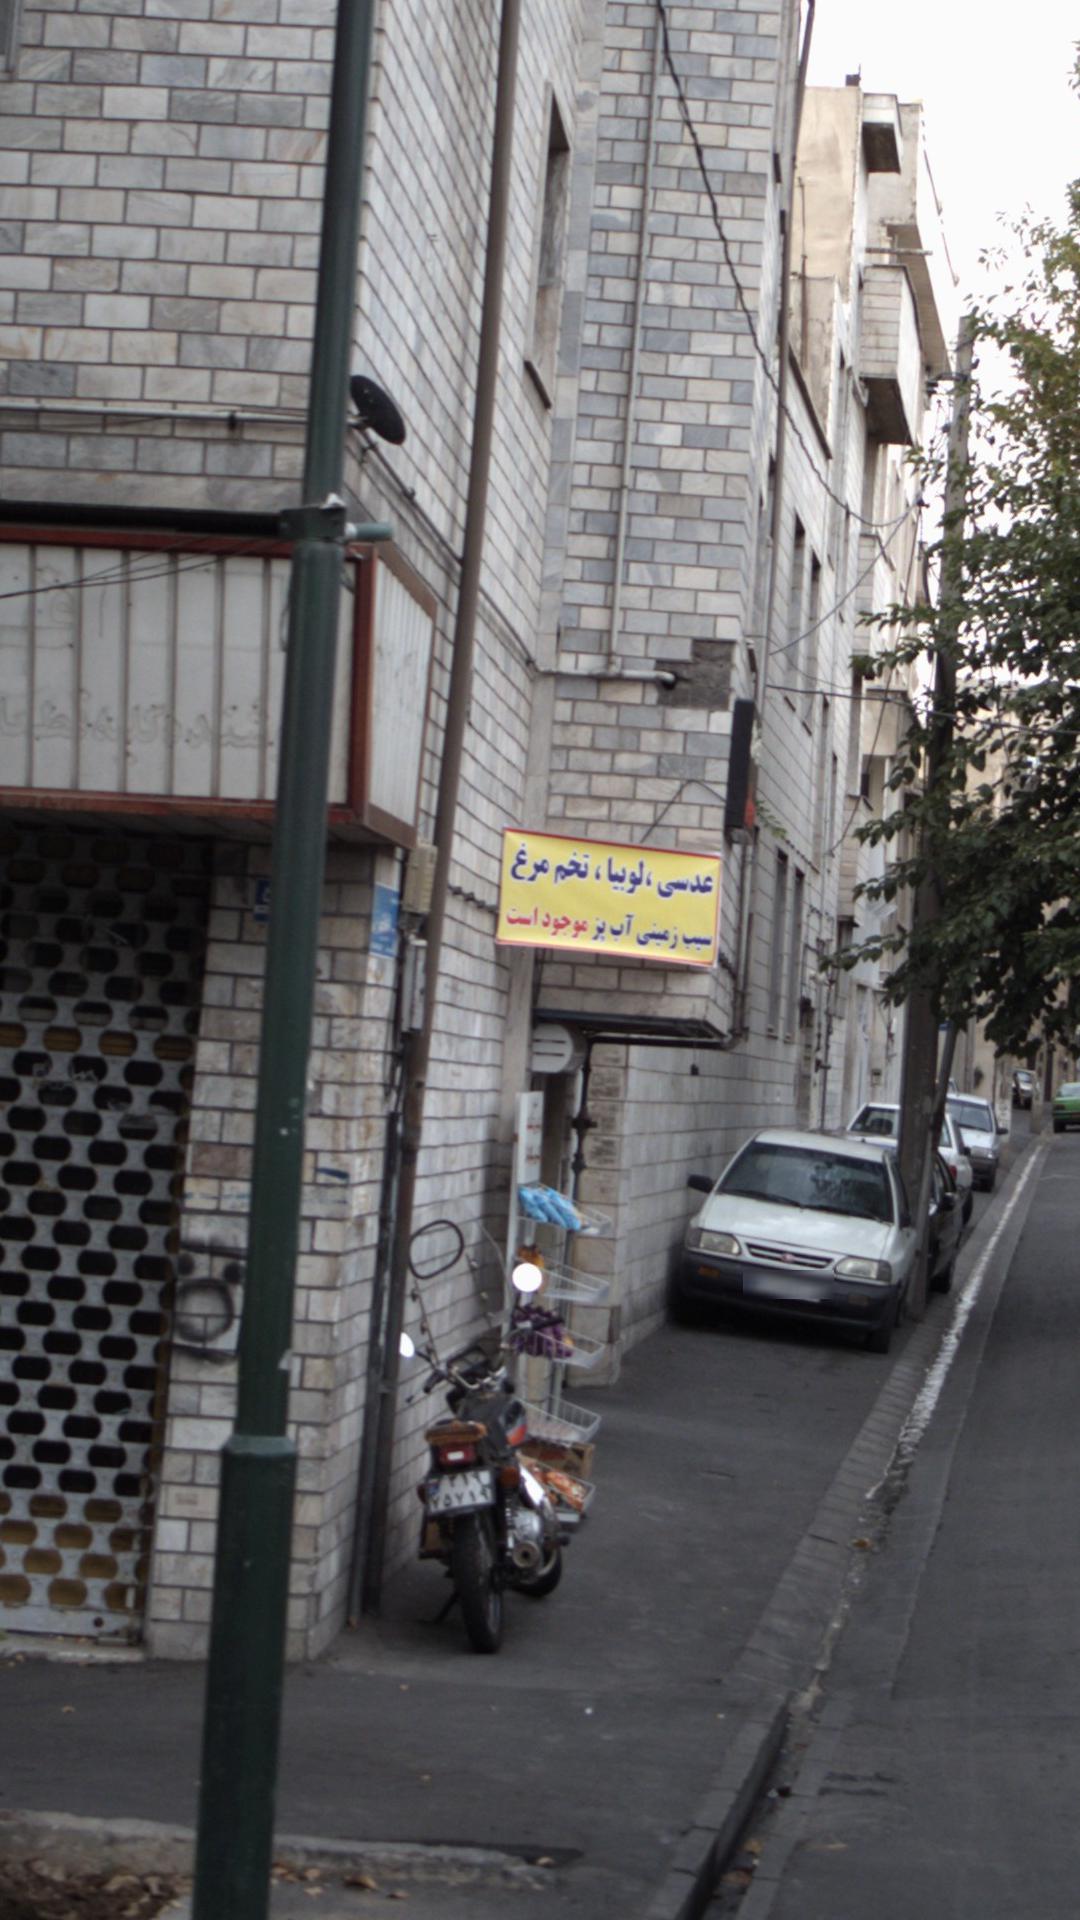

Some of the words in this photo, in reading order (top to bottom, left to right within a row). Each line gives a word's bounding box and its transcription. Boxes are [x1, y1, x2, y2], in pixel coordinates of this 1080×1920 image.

[511, 843, 549, 882] مرغ
[554, 852, 589, 883] تخم
[507, 906, 538, 926] است
[541, 912, 588, 938] موجود
[610, 914, 634, 941] آب
[636, 925, 677, 949] زمینی
[681, 933, 712, 951] سیب
